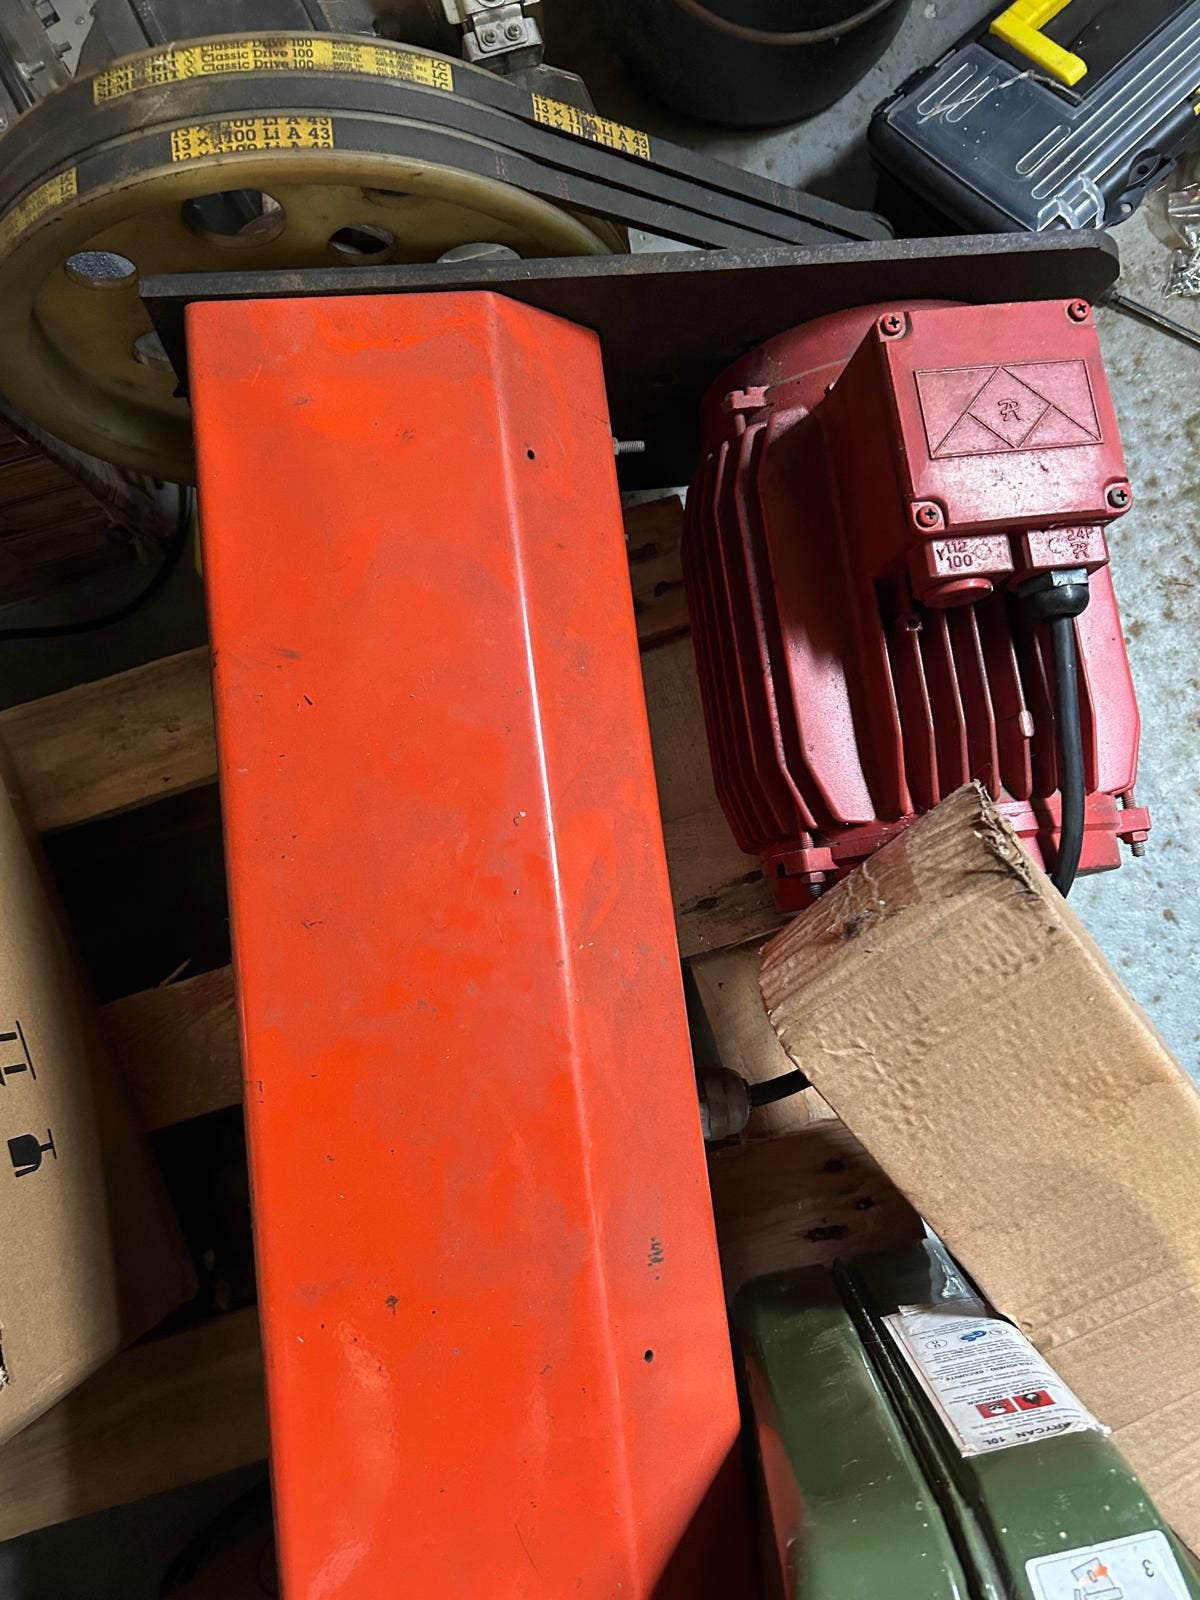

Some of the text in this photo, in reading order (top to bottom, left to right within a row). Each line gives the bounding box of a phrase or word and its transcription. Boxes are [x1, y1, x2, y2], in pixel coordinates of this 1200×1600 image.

[201, 51, 249, 63] Classic
[253, 49, 288, 58] Drive
[293, 49, 314, 58] 100
[201, 60, 250, 72] Classic
[254, 60, 289, 69] Drive
[293, 60, 314, 69] 100
[432, 70, 449, 81] LC
[535, 100, 549, 114] 13
[602, 124, 614, 137] Li
[619, 130, 629, 143] A
[632, 136, 648, 148] 43
[174, 139, 192, 152] 13
[263, 128, 279, 140] Li
[287, 127, 302, 140] A
[308, 128, 331, 140] 43
[946, 554, 973, 569] 100
